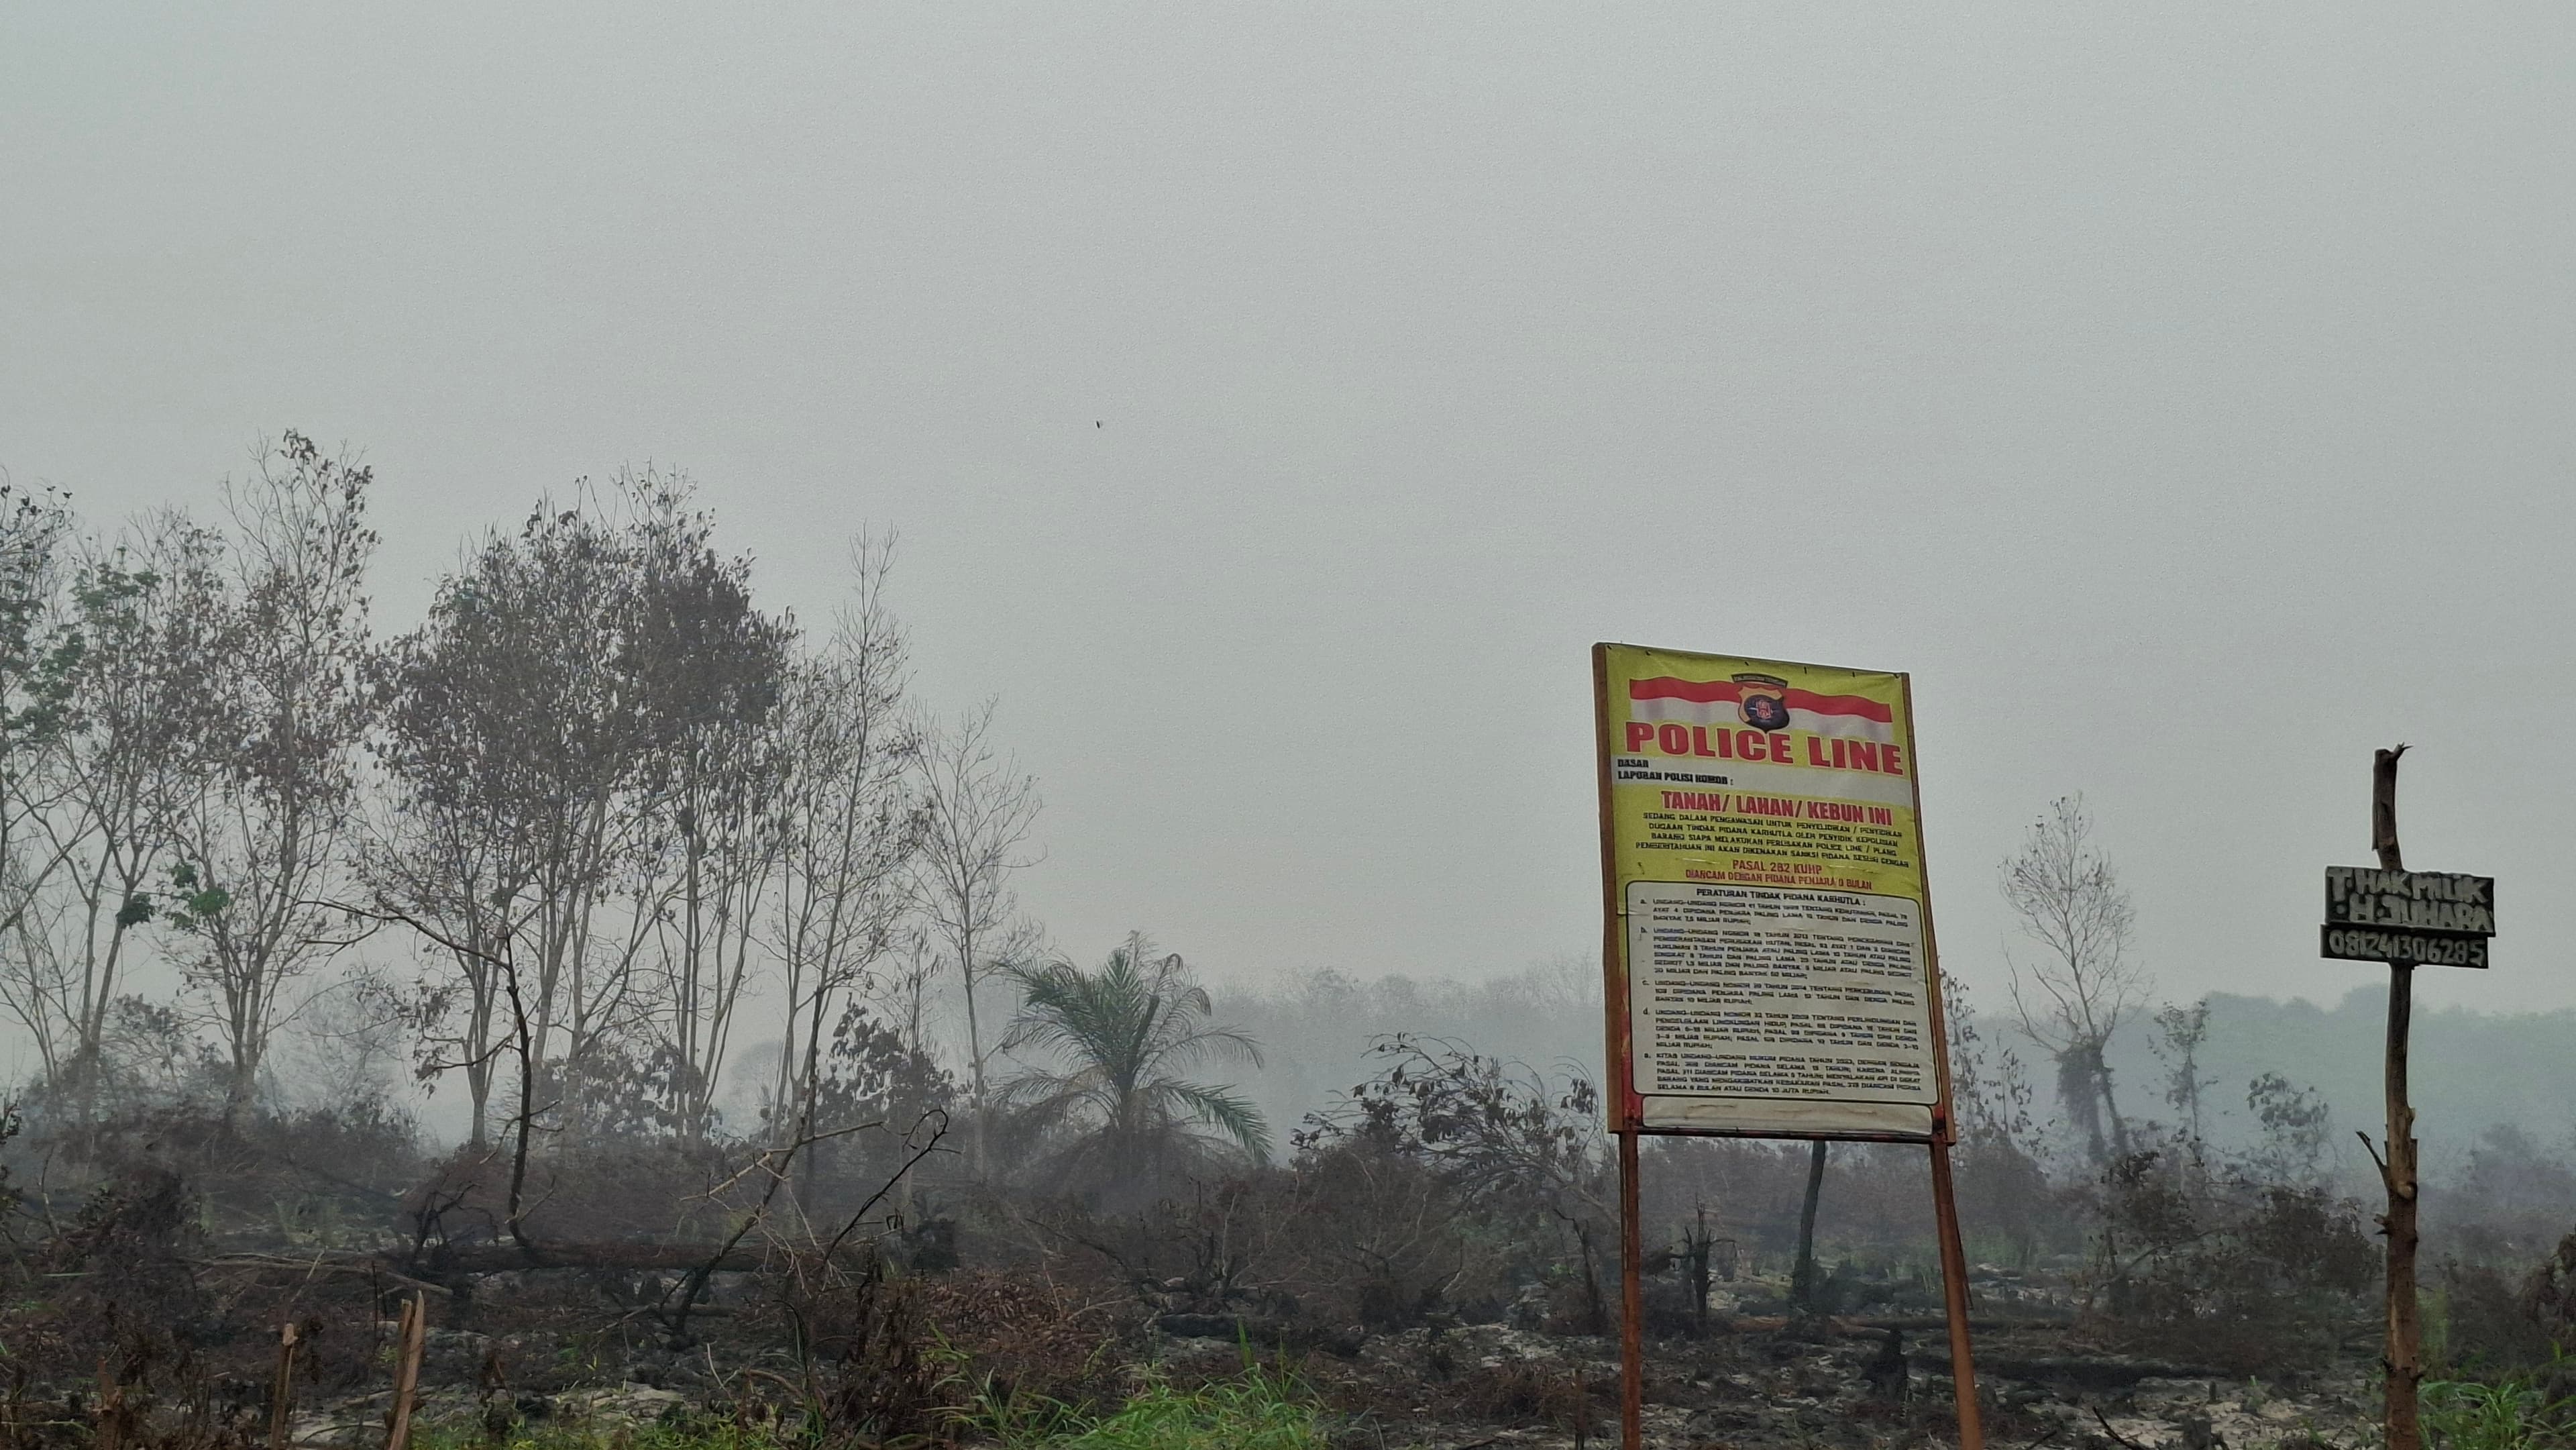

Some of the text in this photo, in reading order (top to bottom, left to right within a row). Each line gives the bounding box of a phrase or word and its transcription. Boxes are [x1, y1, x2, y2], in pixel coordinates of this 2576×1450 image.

[1625, 721, 1903, 776] POLICE LINE
[1617, 759, 1649, 768] DASAR
[1618, 771, 1662, 780] LAPORAN
[1664, 772, 1693, 782] POLISI
[1661, 790, 1892, 826] TANAH/ LAHAN/ KEBUN INI
[1679, 814, 1707, 822] DALAM
[1648, 823, 1683, 831] DUGAAN
[1719, 826, 1748, 834] PIDANA
[1819, 833, 1853, 843] PENYIDIK
[1718, 845, 1739, 853] AKAN
[1821, 852, 1850, 860] PIDANA
[1732, 859, 1766, 872] PASAL
[1793, 863, 1823, 875] KUHP
[1765, 873, 1796, 884] PIDANA
[1799, 876, 1835, 886] PENJARA
[1846, 879, 1872, 890] BULAN
